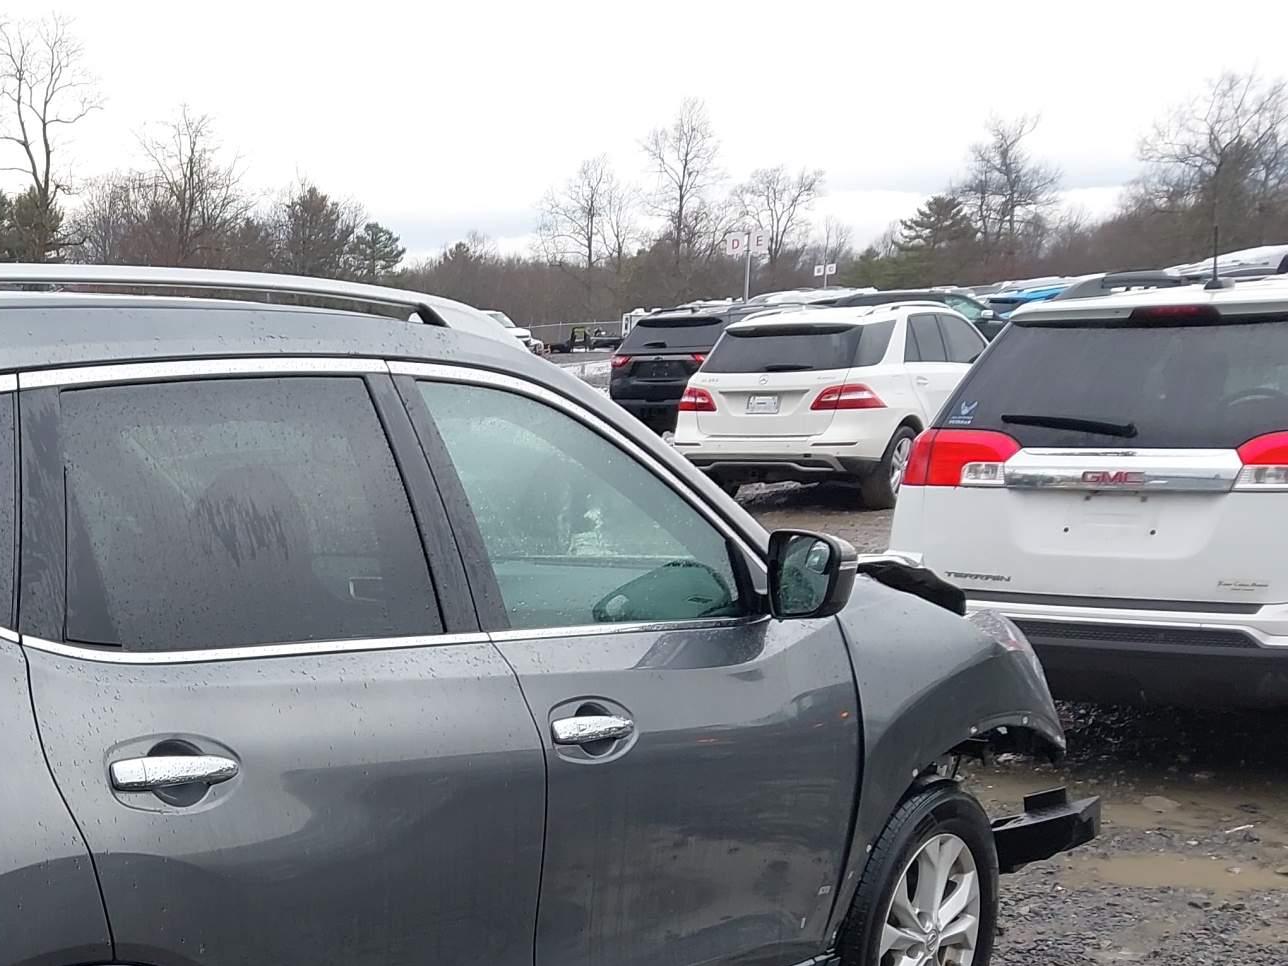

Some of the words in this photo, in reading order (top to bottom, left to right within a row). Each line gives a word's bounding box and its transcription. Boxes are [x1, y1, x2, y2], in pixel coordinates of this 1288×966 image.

[731, 238, 740, 250] D
[755, 235, 764, 247] E
[1080, 471, 1145, 485] GMC
